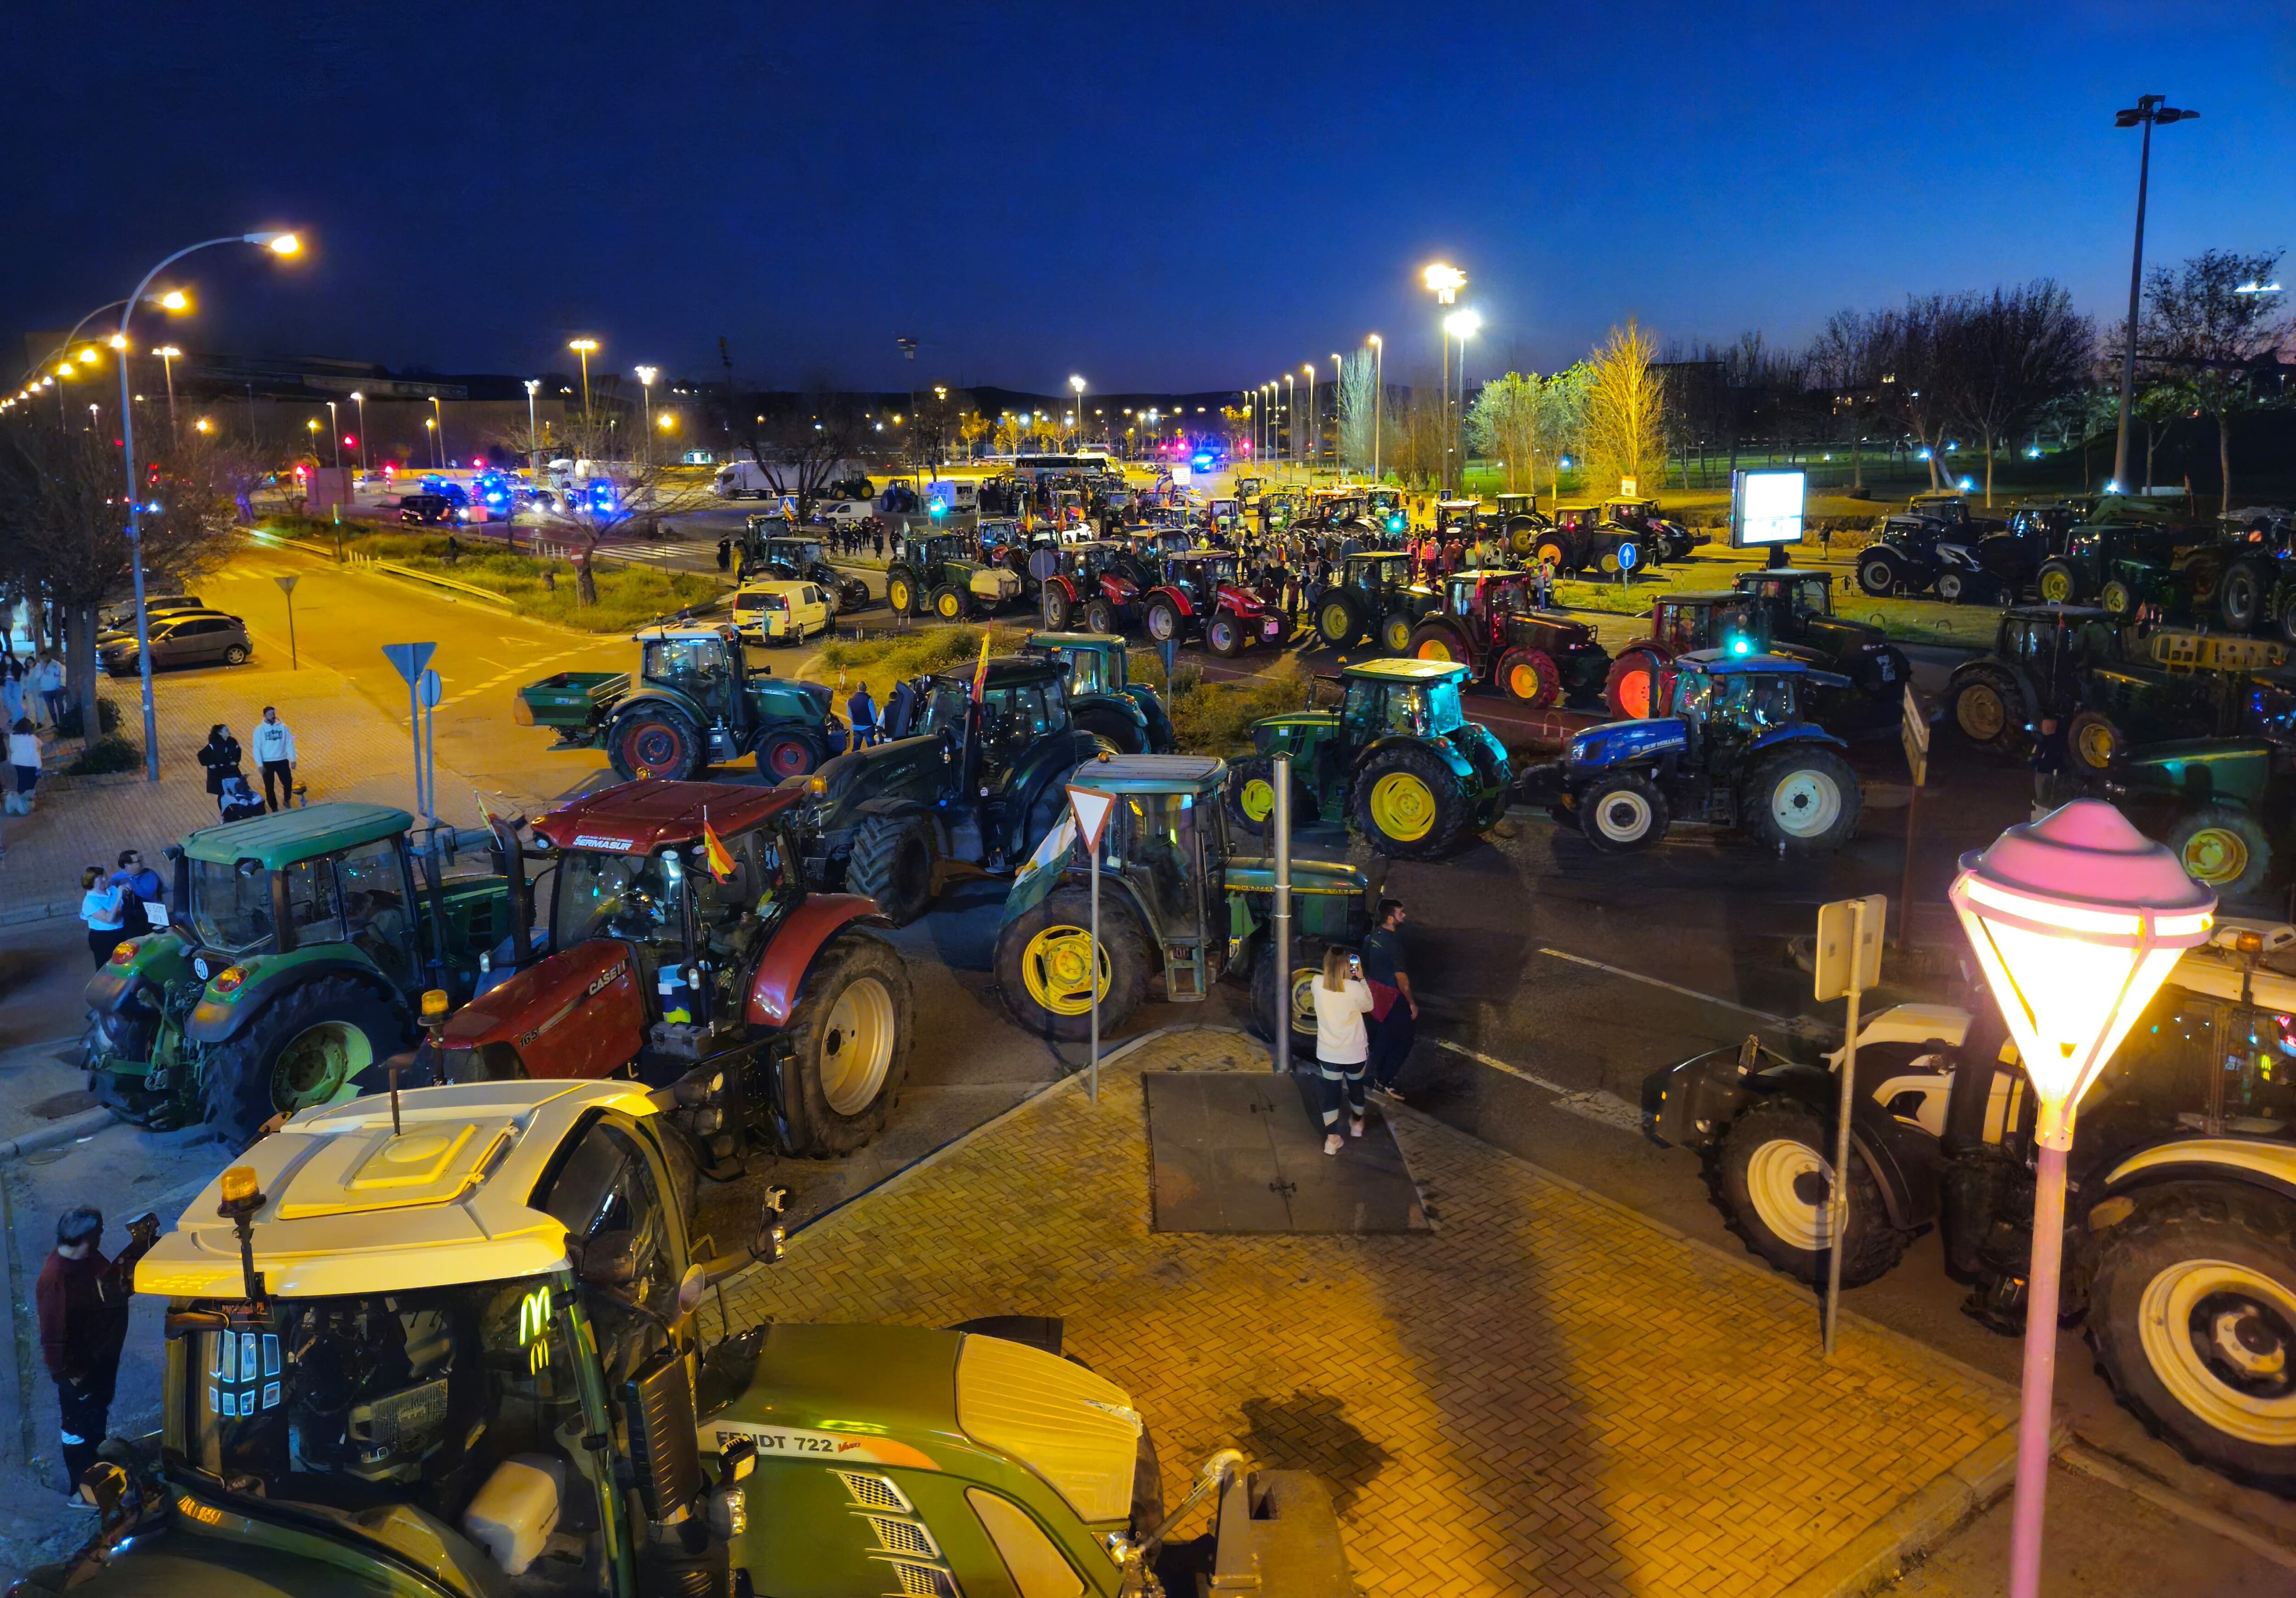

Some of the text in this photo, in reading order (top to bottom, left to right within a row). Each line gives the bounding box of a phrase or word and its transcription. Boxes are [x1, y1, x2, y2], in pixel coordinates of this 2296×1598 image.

[1657, 737, 1684, 746] HOLLAND
[573, 835, 632, 850] SERMASUR
[196, 960, 206, 978] 40
[589, 966, 618, 995] CASE
[520, 1030, 539, 1048] 165
[794, 1437, 833, 1452] 722
